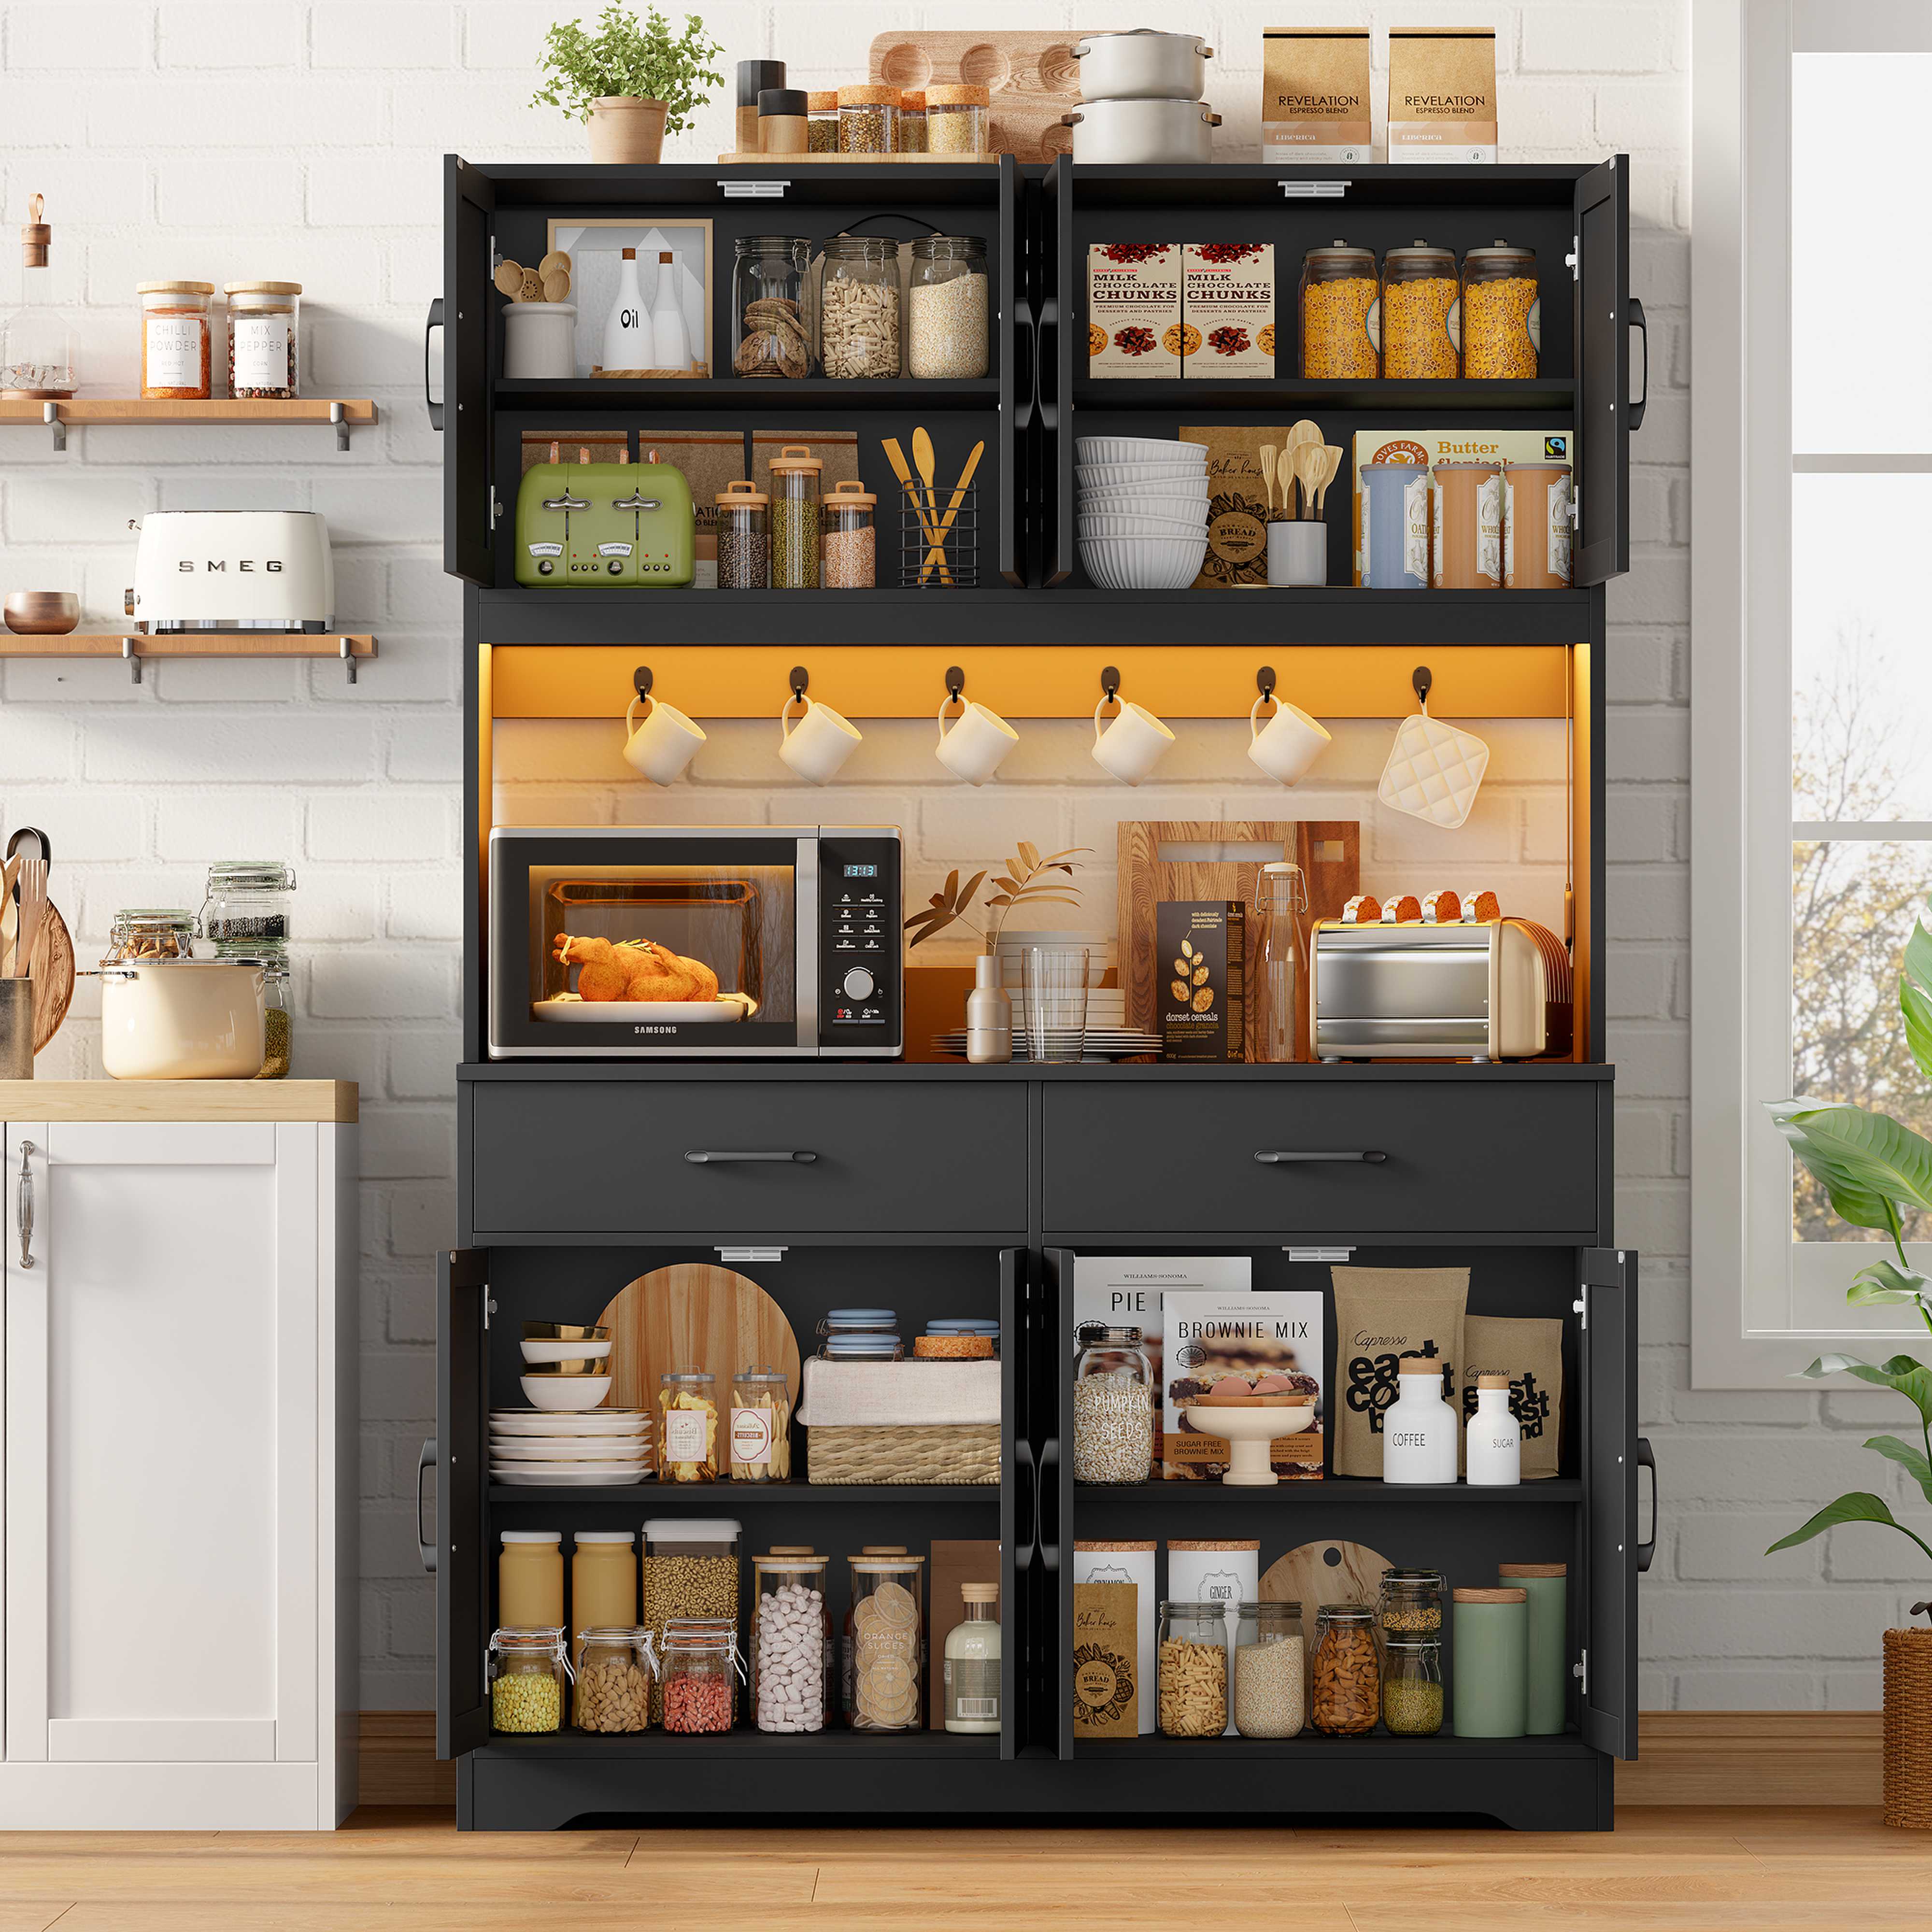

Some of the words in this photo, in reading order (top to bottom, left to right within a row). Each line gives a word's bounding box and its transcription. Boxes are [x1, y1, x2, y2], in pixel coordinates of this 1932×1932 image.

[1279, 96, 1359, 106] REVELATION
[1405, 96, 1485, 106] REVELATION
[1093, 291, 1177, 299] CHUNKS
[1187, 291, 1271, 299] CHUNKS
[621, 309, 639, 328] Oil
[155, 326, 190, 335] CHILLI
[251, 326, 270, 335] MIX
[150, 341, 197, 351] POWDER
[241, 341, 282, 351] PEPPER
[1401, 443, 1424, 459] FARM
[1437, 441, 1499, 454] Butter
[1220, 528, 1256, 537] BREAD
[179, 561, 282, 572] SMEG
[847, 866, 874, 876] 13:13
[1166, 1012, 1191, 1021] dorset
[1191, 1012, 1219, 1021] cereals
[1112, 1293, 1146, 1312] PIE
[1179, 1322, 1264, 1338] BROWNIE
[1276, 1322, 1308, 1338] MIX
[1352, 1330, 1407, 1351] Capresso
[1095, 1394, 1149, 1412] PUMPKIN
[1102, 1422, 1143, 1439] SEEDS
[1393, 1434, 1425, 1446] COFFEE
[1493, 1439, 1514, 1448] SUGAR
[1209, 1585, 1233, 1599] GINGER
